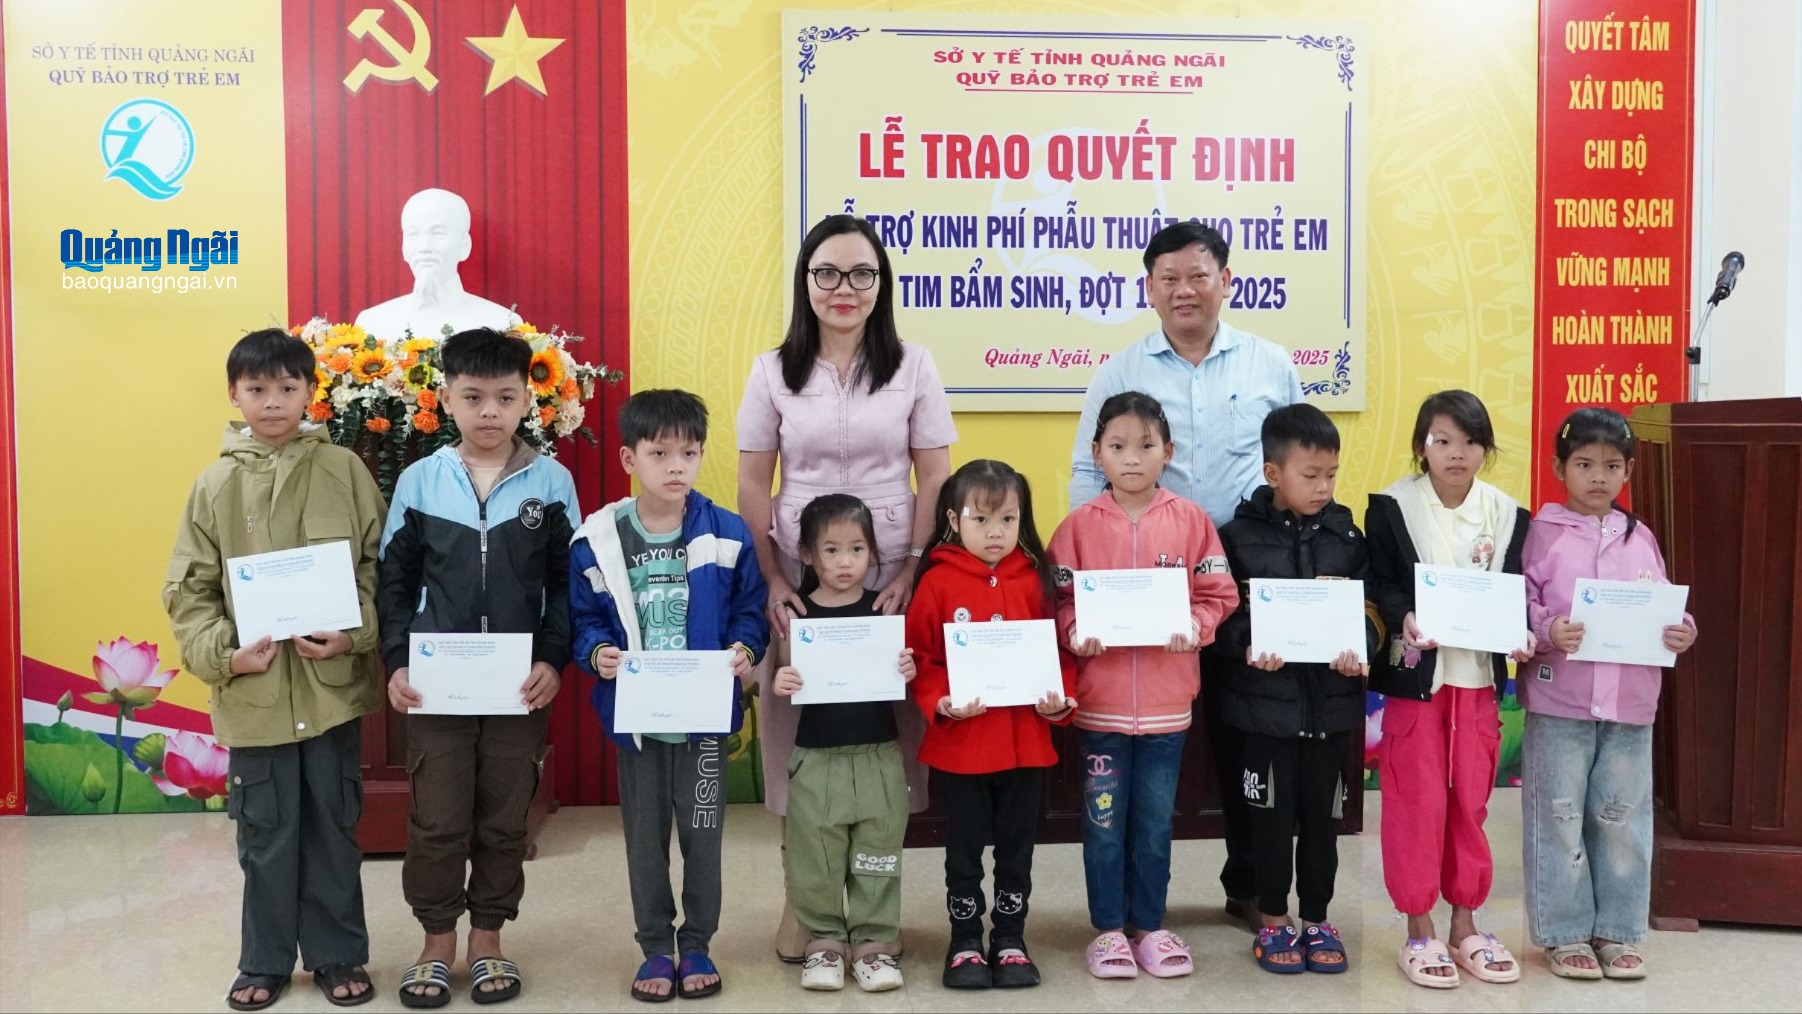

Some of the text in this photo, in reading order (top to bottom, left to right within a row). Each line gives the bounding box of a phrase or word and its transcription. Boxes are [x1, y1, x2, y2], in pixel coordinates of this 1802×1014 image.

[1565, 11, 1669, 53] QUYẾT TÂM
[32, 42, 255, 64] SỞ Y TẾ TỈNH QUẢNG NGÃI
[934, 47, 1225, 67] SỞ Y TẾ TỈNH QUẢNG NGÃI
[48, 66, 241, 88] QUỸ BẢO TRỢ TRẺ EM
[956, 69, 1203, 88] QUỸ BẢO TRỢ TRẺ EM
[1569, 74, 1664, 117] XÂY DỰNG
[860, 116, 1295, 191] LỄ TRAO QUYẾT ĐỊNH
[1584, 133, 1647, 176] CHI BỘ
[866, 210, 915, 255] TRỢ
[922, 215, 977, 248] KINH
[987, 207, 1026, 249] PHÍ
[1034, 201, 1095, 249] PHẪU
[1240, 205, 1284, 250] TRẺ
[1294, 219, 1327, 250] EM
[1554, 198, 1674, 234] TRONG SẠCH
[899, 275, 941, 308] TIM
[951, 258, 1003, 308] BẨM
[1010, 275, 1071, 315] SINH,
[1079, 271, 1125, 315] ĐỢT
[1230, 277, 1286, 309] 2025
[1556, 251, 1670, 293] VỮNG MẠNH
[1552, 310, 1672, 345] HOÀN THÀNH
[985, 348, 1042, 368] Quảng
[1046, 349, 1092, 368] Ngãi,
[1293, 350, 1330, 365] 2025
[1565, 363, 1658, 403] XUẤT SẮC
[855, 860, 895, 871] LUCK
[857, 853, 897, 864] GOOD
